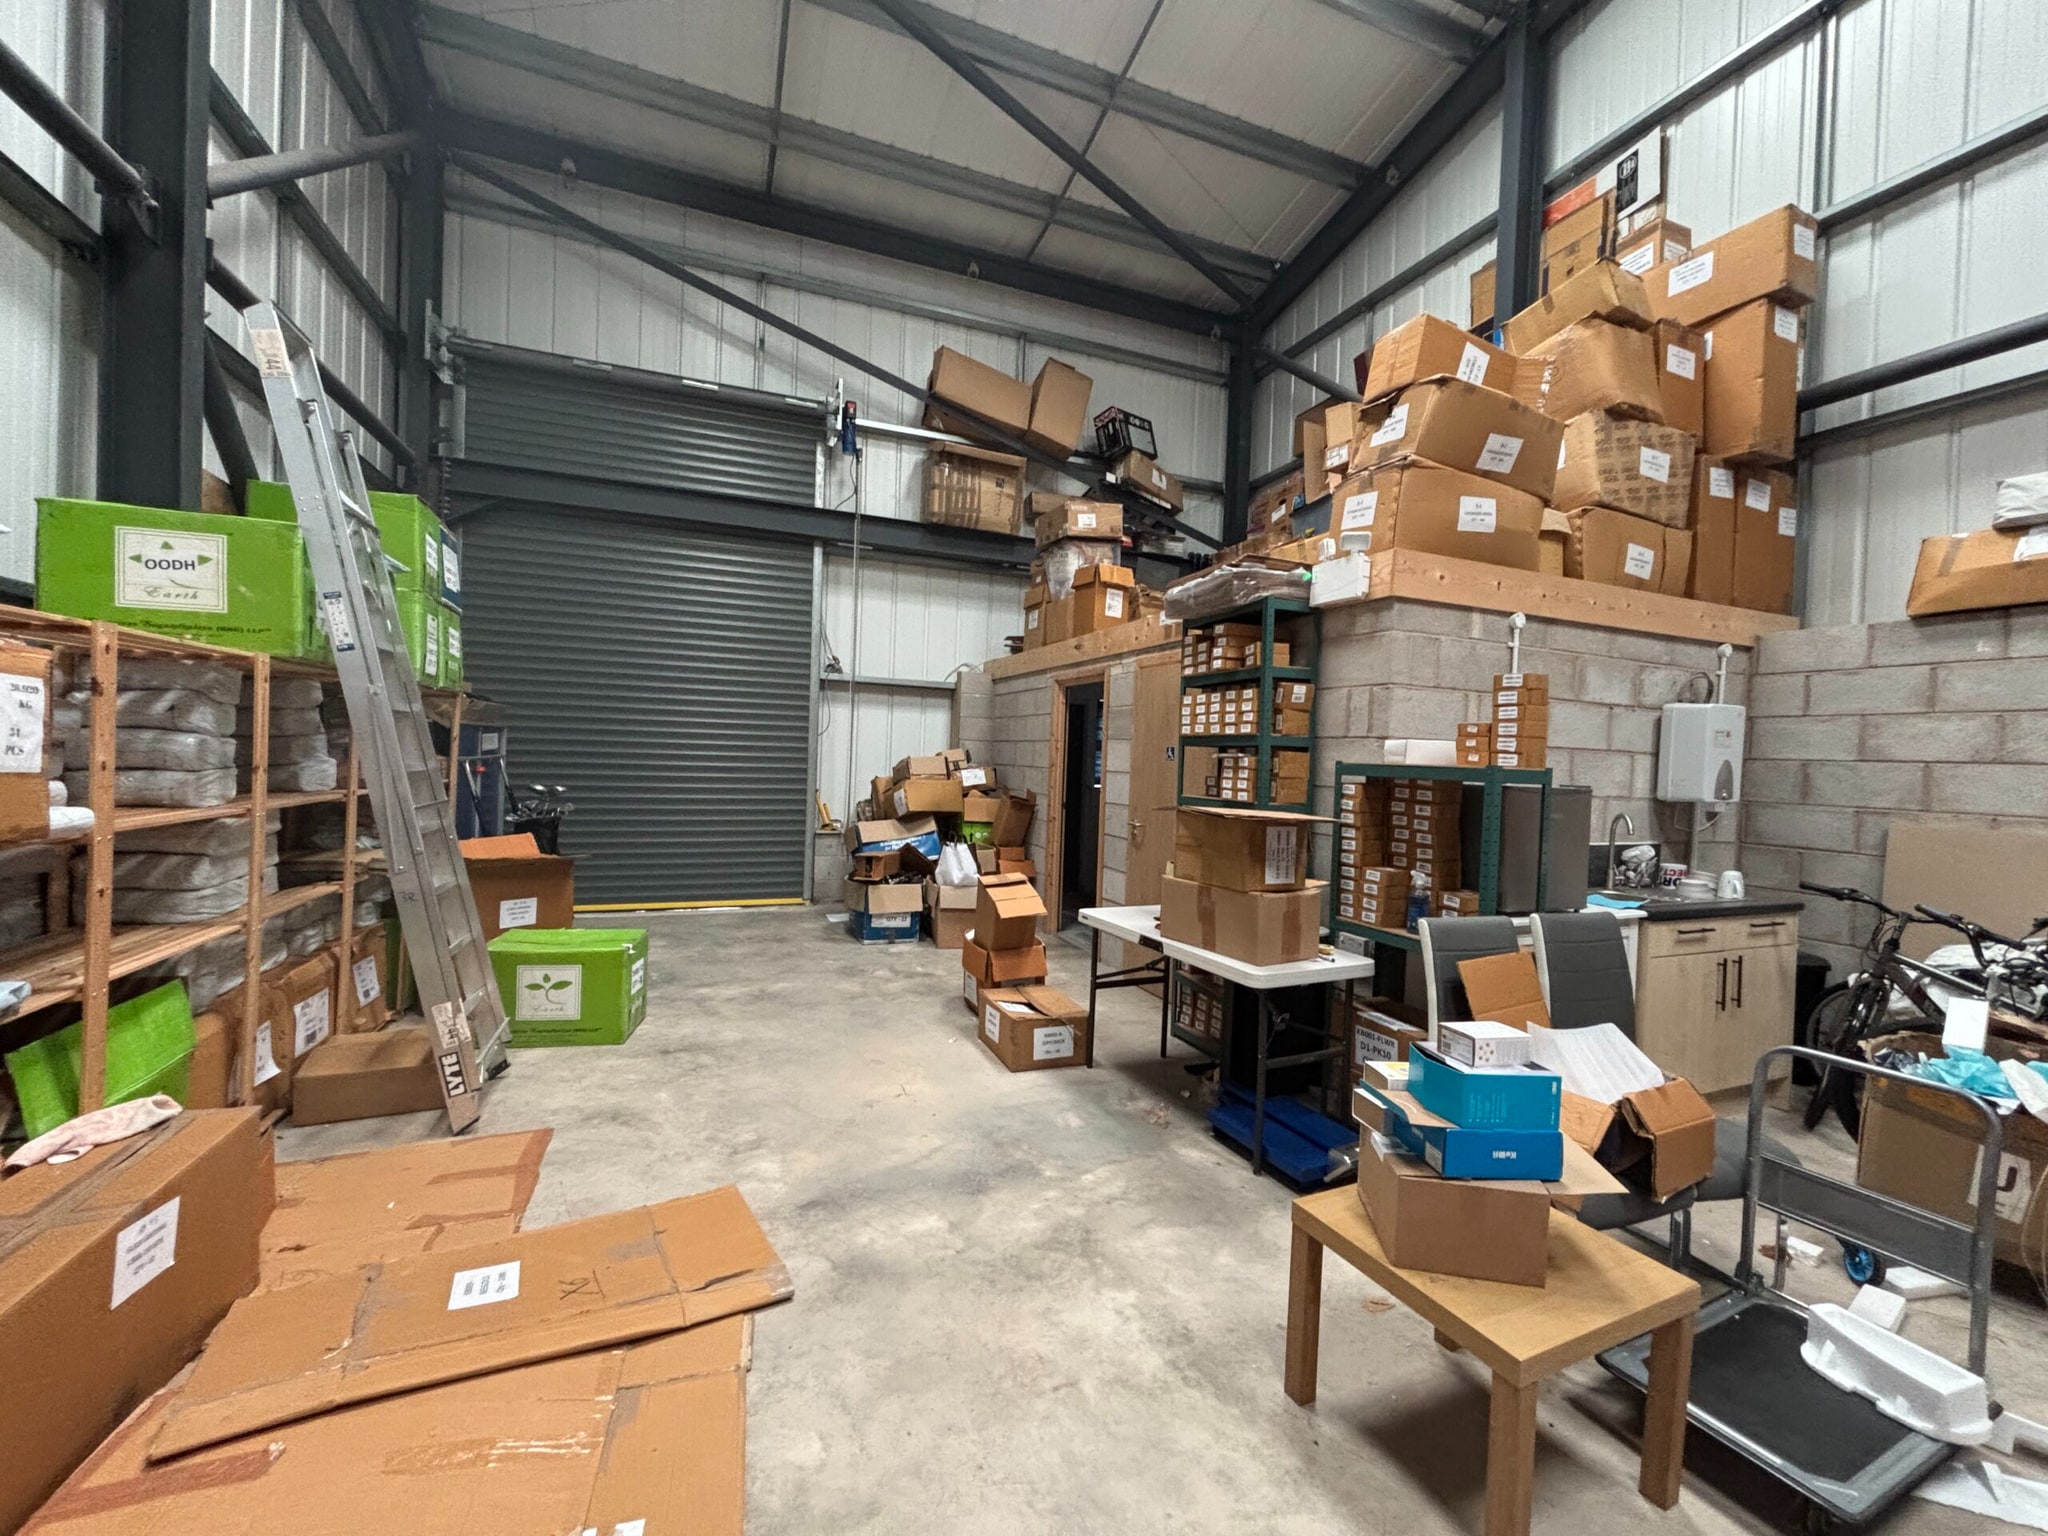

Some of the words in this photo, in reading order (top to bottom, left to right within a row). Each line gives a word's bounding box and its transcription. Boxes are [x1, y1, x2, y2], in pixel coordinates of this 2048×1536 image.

[144, 558, 196, 571] OODH
[144, 586, 199, 600] Earth
[1360, 1041, 1392, 1060] D1-PK10
[441, 1053, 466, 1097] LYTE
